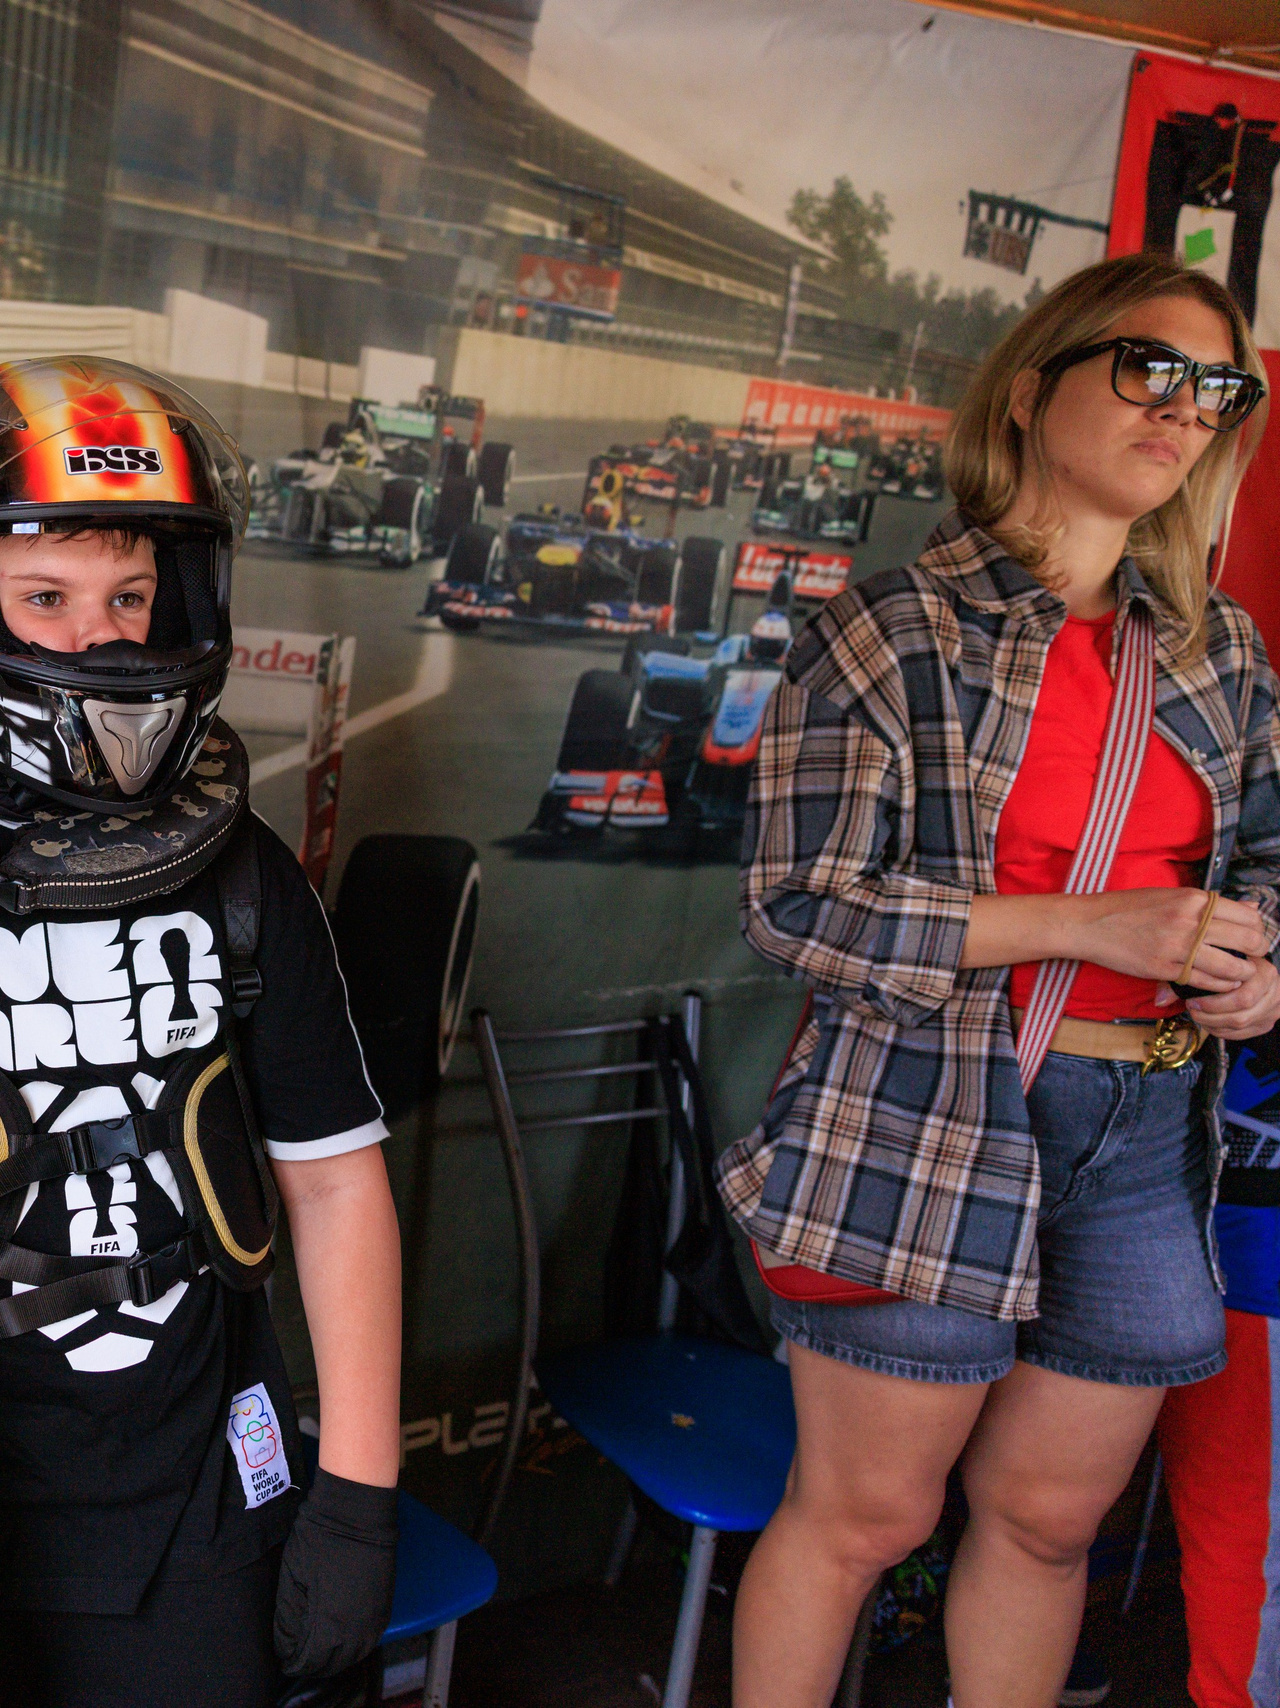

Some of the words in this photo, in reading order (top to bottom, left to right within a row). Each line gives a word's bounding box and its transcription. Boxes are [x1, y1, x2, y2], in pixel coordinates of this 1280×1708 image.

[166, 1026, 197, 1045] FIFA
[90, 1240, 121, 1255] FIFA
[250, 1468, 269, 1483] FIFA
[253, 1472, 280, 1493] WORLD
[255, 1487, 271, 1502] CUP
